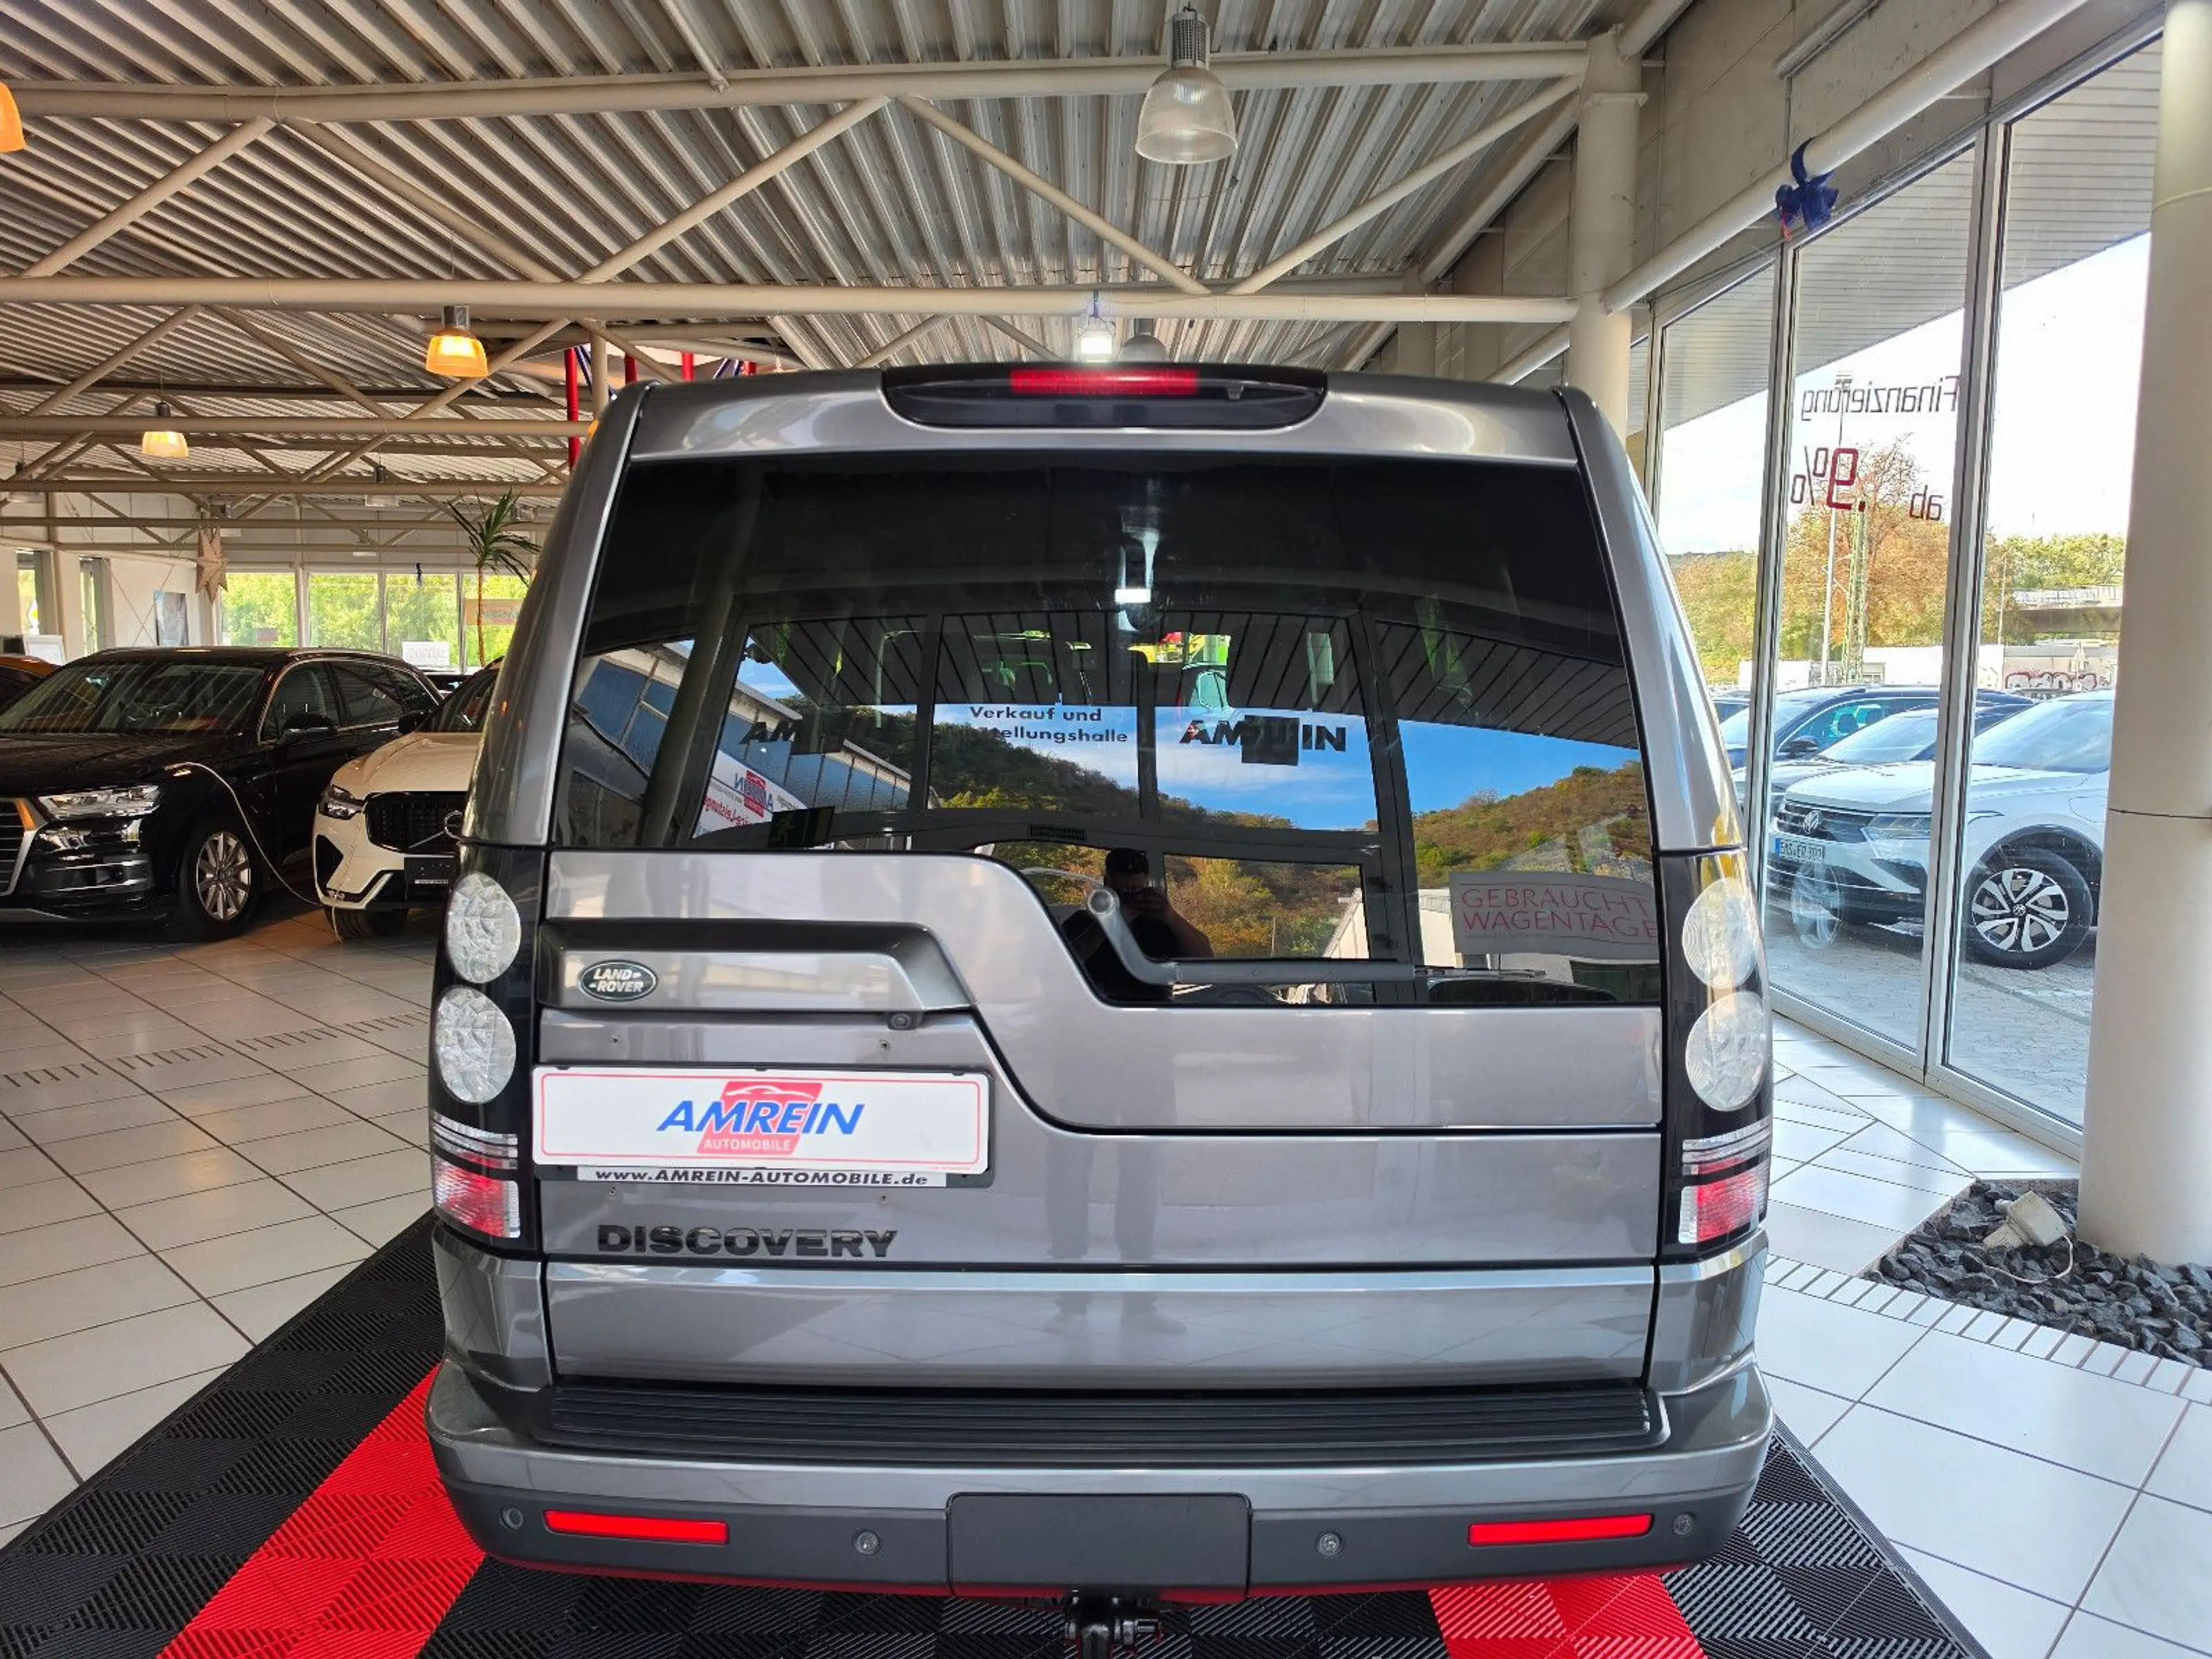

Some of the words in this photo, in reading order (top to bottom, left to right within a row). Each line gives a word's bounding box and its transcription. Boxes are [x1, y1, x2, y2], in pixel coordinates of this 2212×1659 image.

[969, 706, 1055, 720] Verkauf
[1063, 709, 1101, 721] und
[1179, 718, 1346, 752] AMIN
[1462, 889, 1649, 918] GEBRAUCHT
[593, 968, 632, 980] LAND
[596, 981, 644, 993] ROVER
[656, 1100, 865, 1135] AMREIN
[703, 1138, 791, 1152] AUTOMOBILE
[596, 1169, 928, 1186] www.AMREIN-AUTOMOBILE.de
[597, 1224, 898, 1258] DISCOVERY
